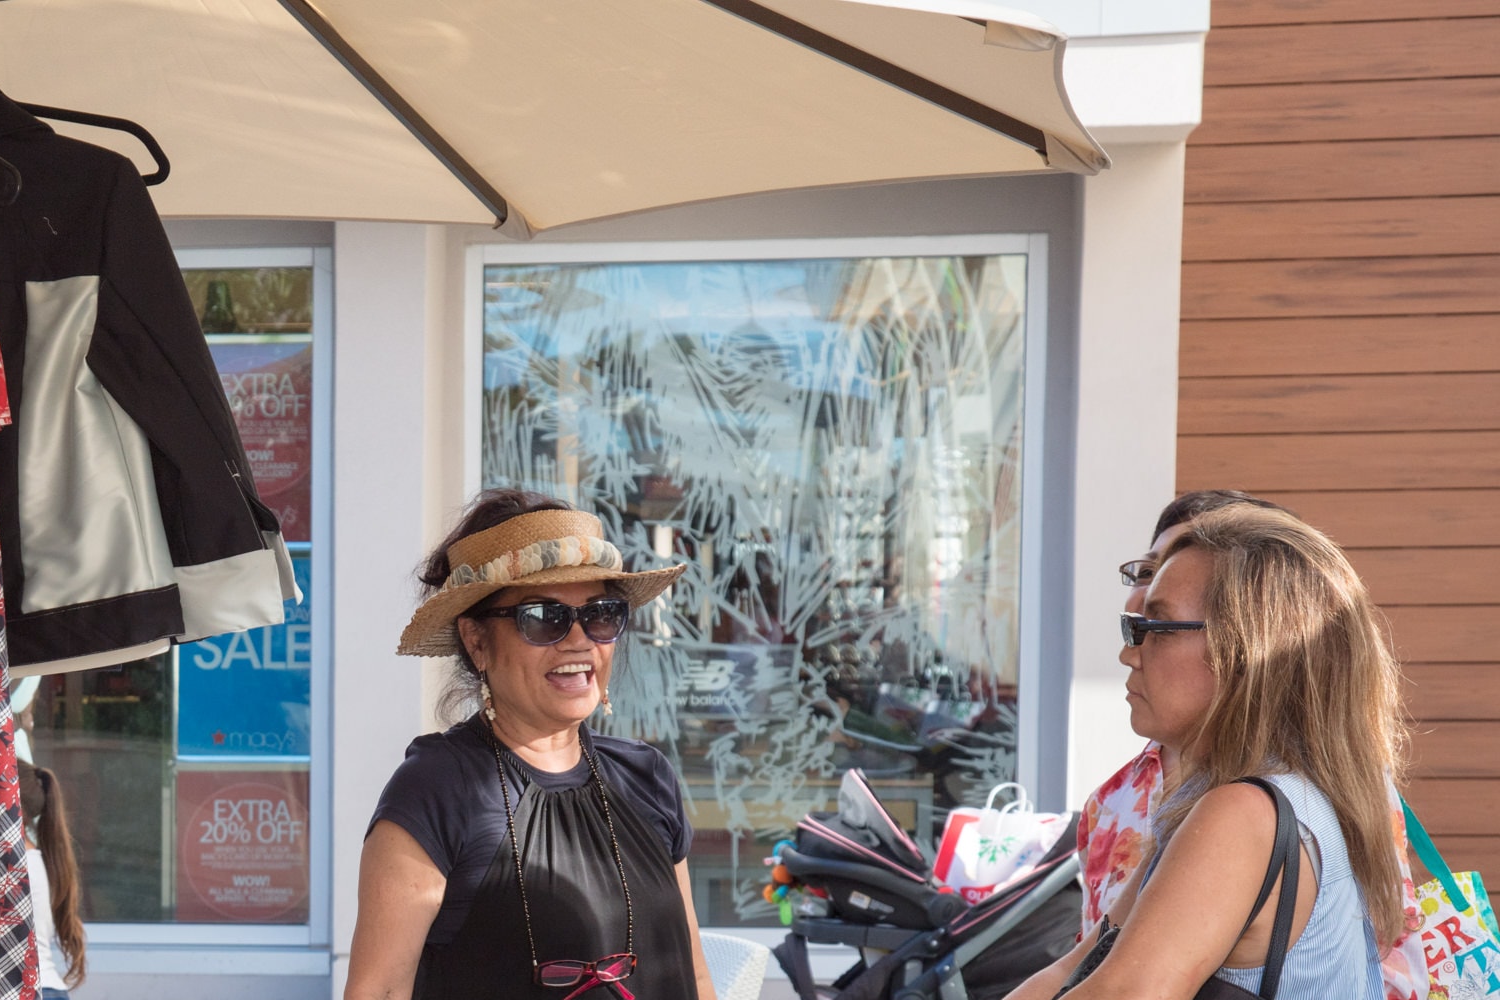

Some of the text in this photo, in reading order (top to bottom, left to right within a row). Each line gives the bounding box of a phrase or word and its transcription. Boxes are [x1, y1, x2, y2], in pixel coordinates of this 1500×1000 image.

[220, 373, 295, 395] EXTRA
[261, 394, 306, 417] OFF
[193, 624, 310, 670] SALE
[690, 693, 736, 705] balanc
[229, 730, 296, 751] macy's
[213, 799, 291, 822] EXTRA
[199, 821, 303, 843] 20% OFF
[232, 875, 271, 887] WOW!
